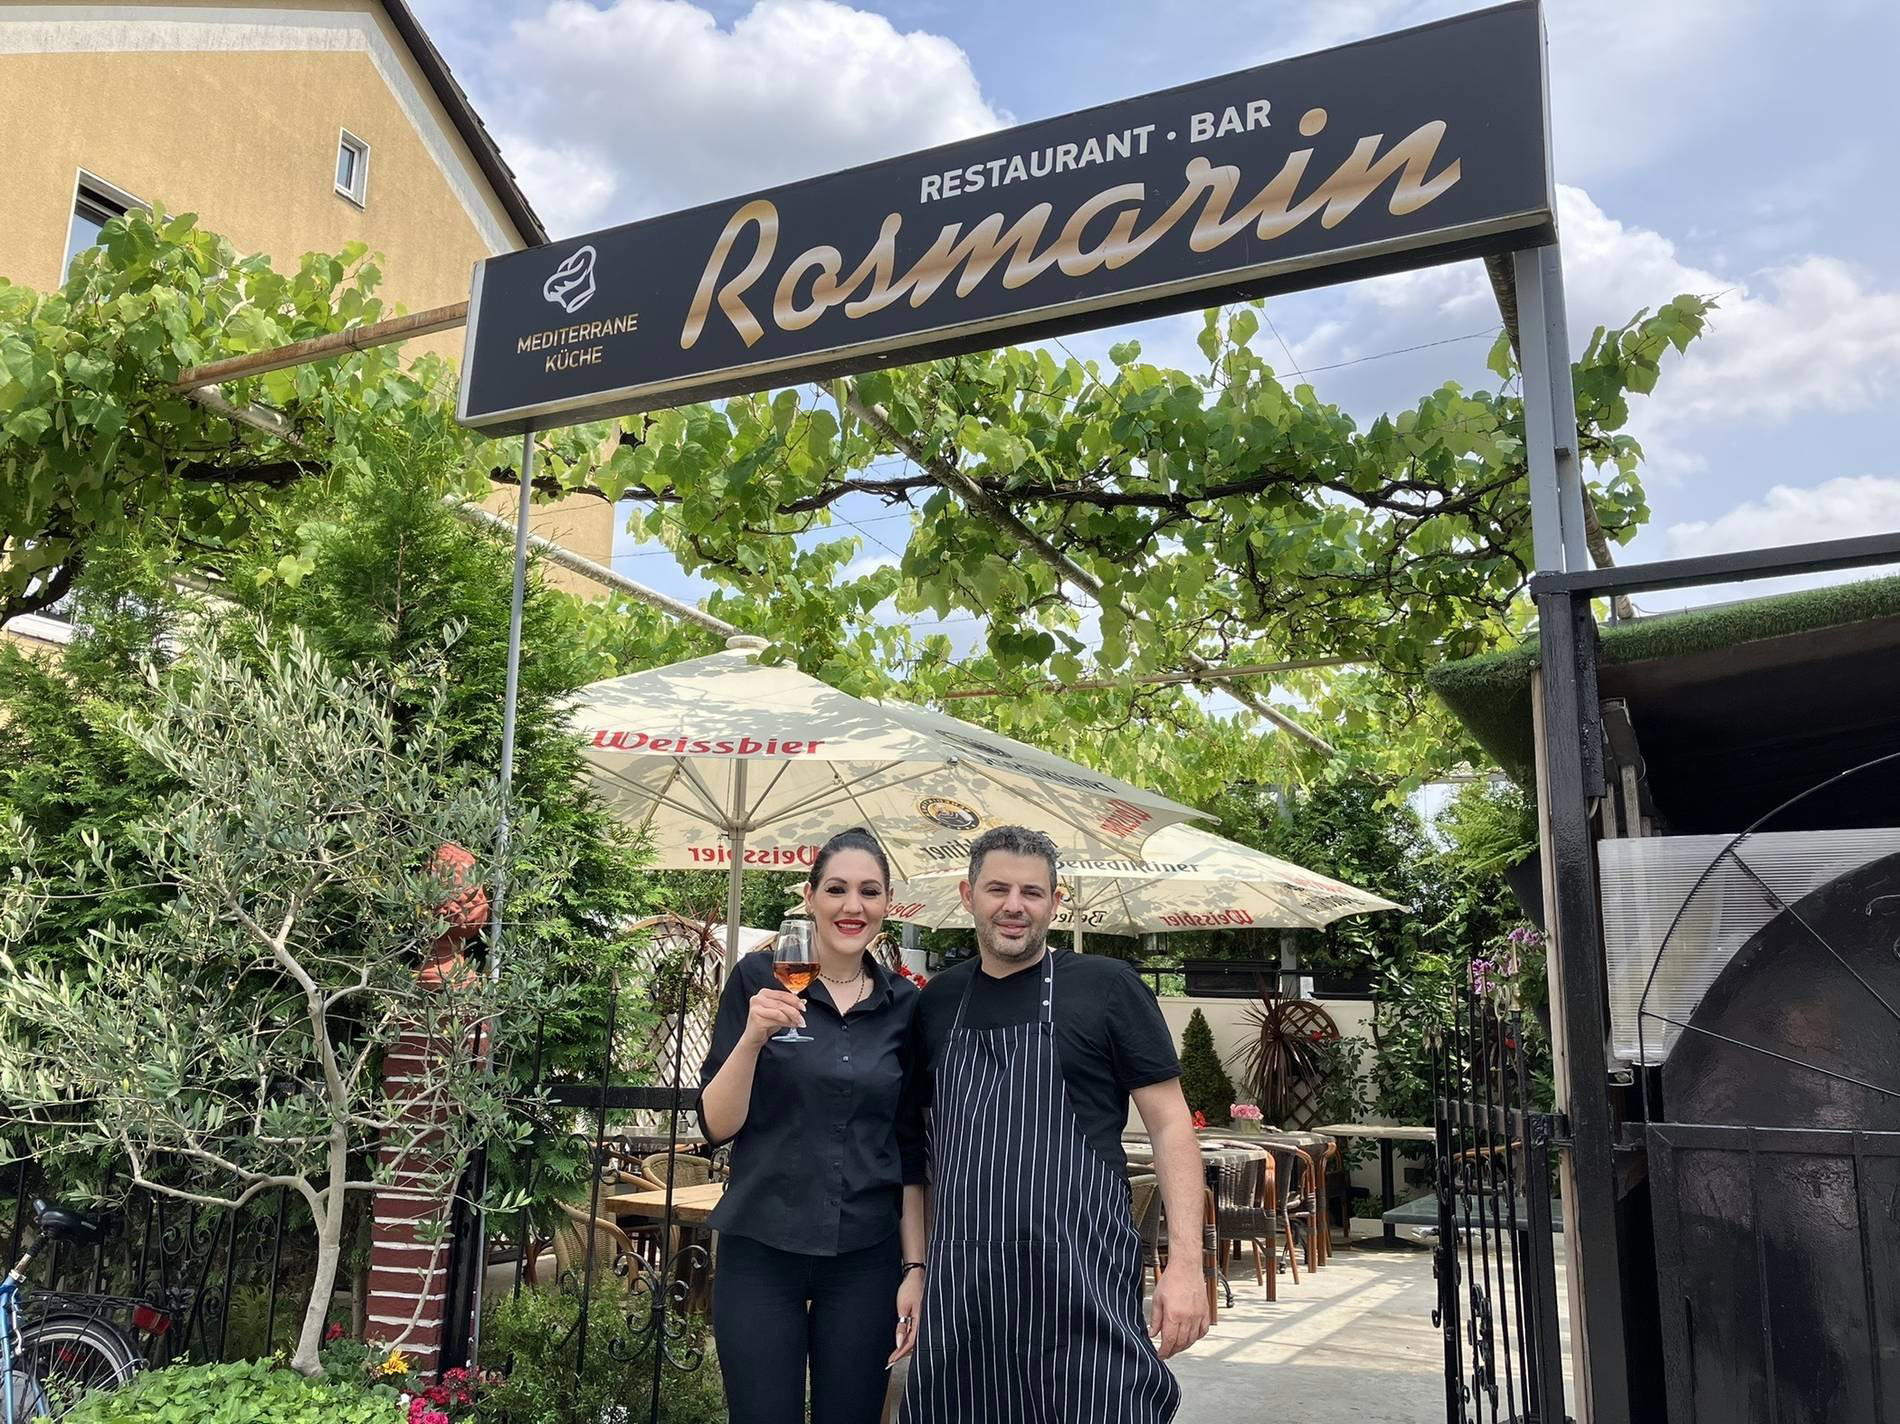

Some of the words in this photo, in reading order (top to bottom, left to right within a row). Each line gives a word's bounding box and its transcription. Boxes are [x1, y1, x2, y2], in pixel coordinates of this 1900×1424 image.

[920, 124, 1156, 204] RESTAURANT
[1190, 99, 1272, 143] BAR
[680, 107, 1462, 350] Rosmarin
[516, 313, 639, 354] MEDITERRANE
[545, 346, 604, 373] KÜCHE
[592, 729, 826, 756] Weissbier
